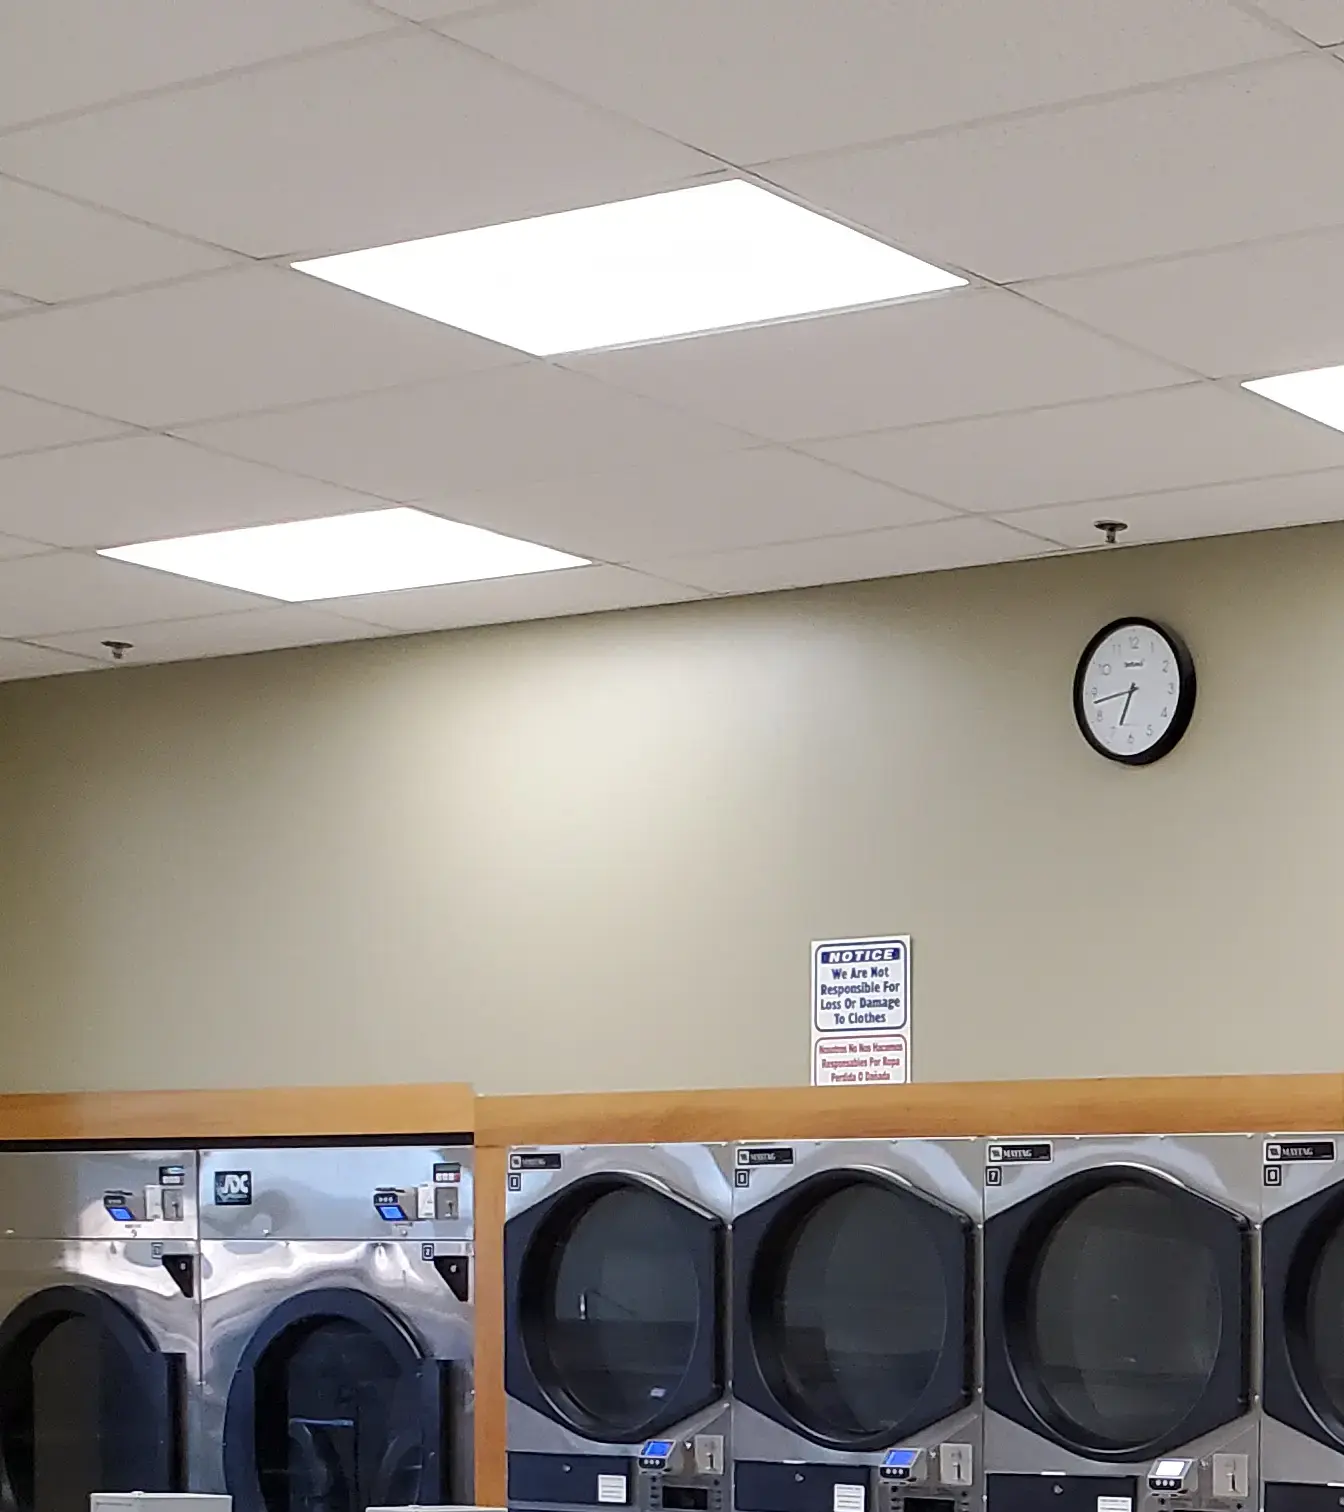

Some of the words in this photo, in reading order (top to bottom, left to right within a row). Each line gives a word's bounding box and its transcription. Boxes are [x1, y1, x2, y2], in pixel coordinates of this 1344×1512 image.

[1129, 636, 1140, 650] 12
[1162, 660, 1169, 673] 2
[1168, 682, 1174, 695] 3
[829, 948, 895, 963] NOTICE
[831, 968, 848, 980] We
[850, 967, 868, 979] Are
[870, 966, 890, 978] Not
[820, 981, 881, 997] Responsible
[883, 980, 901, 992] For
[820, 999, 842, 1010] Loss
[844, 998, 857, 1009] Or
[859, 997, 901, 1010] Damage
[834, 1013, 846, 1025] To
[848, 1012, 887, 1024] Clothes
[1281, 1147, 1314, 1156] MAYTAG
